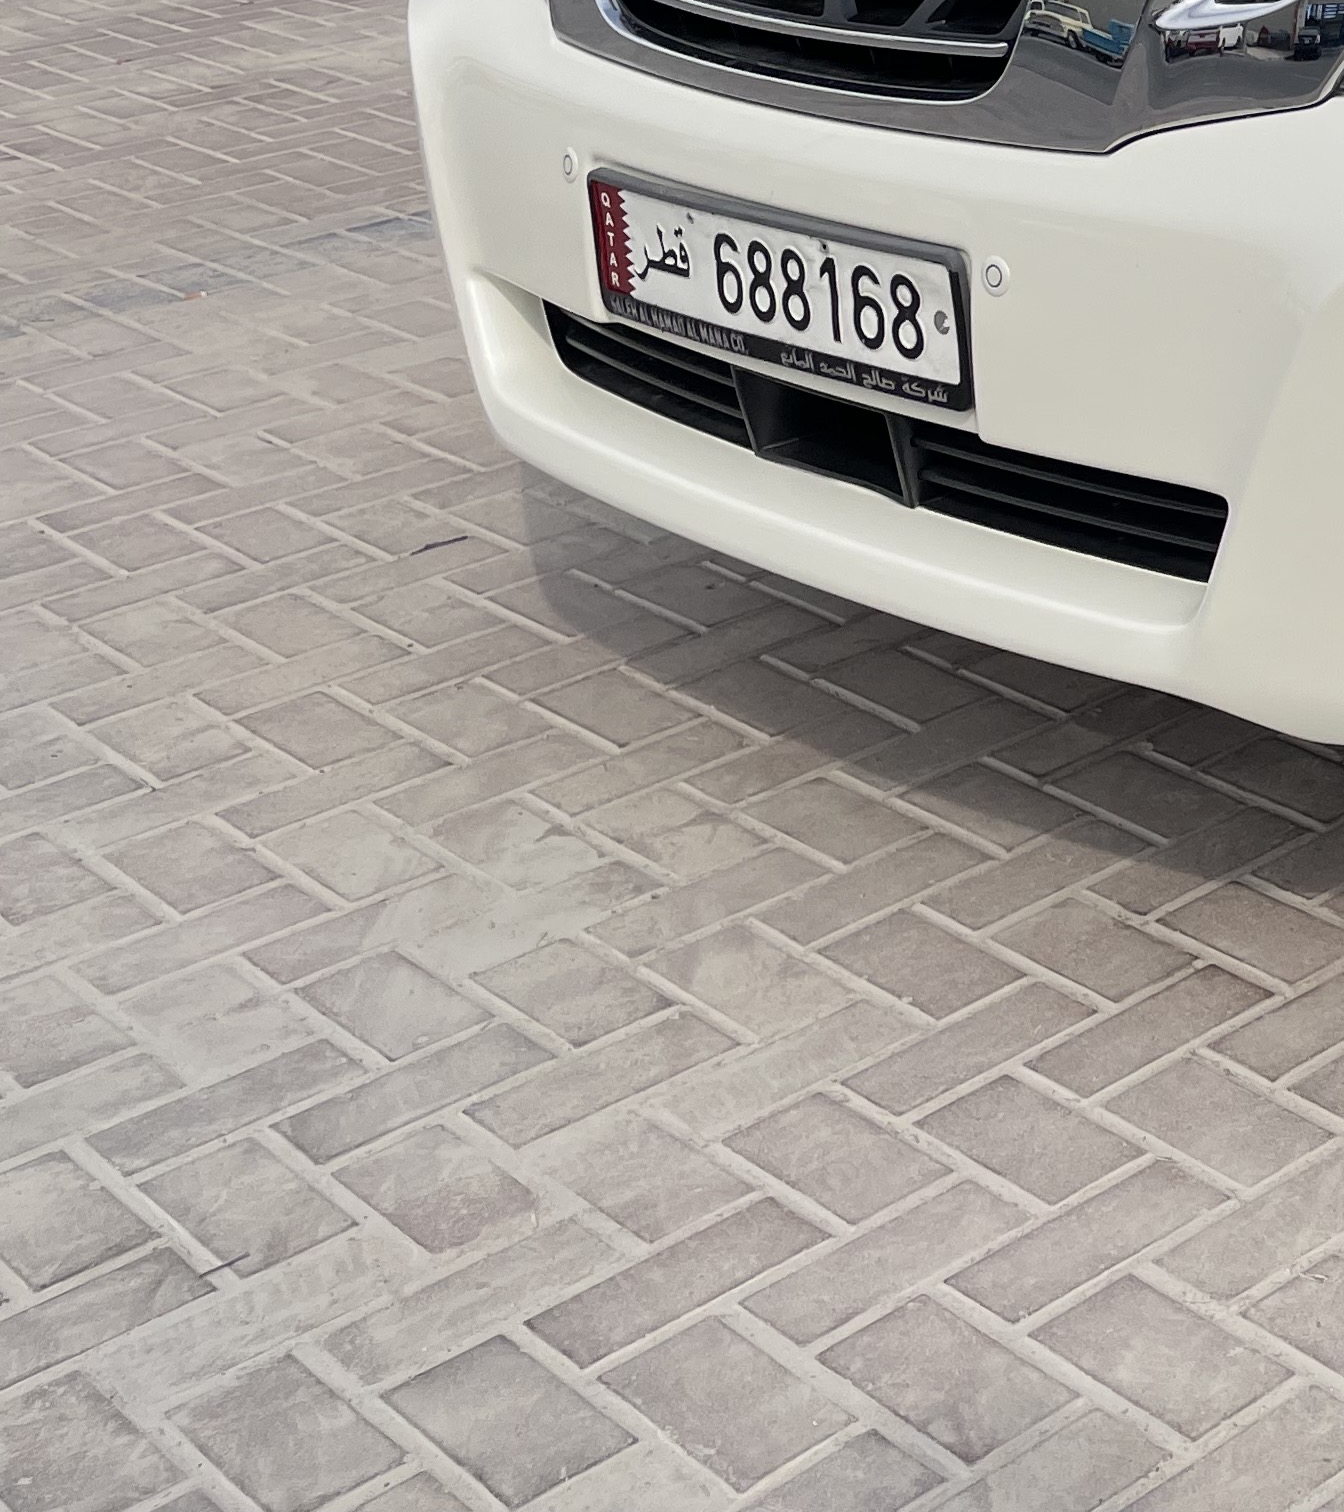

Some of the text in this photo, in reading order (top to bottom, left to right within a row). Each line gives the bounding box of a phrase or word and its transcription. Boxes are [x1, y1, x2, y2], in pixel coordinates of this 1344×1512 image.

[601, 192, 620, 288] QATAR
[634, 224, 690, 280] قطر
[714, 233, 925, 360] 688168
[780, 347, 948, 403] شركة صالح الحمد المانع
